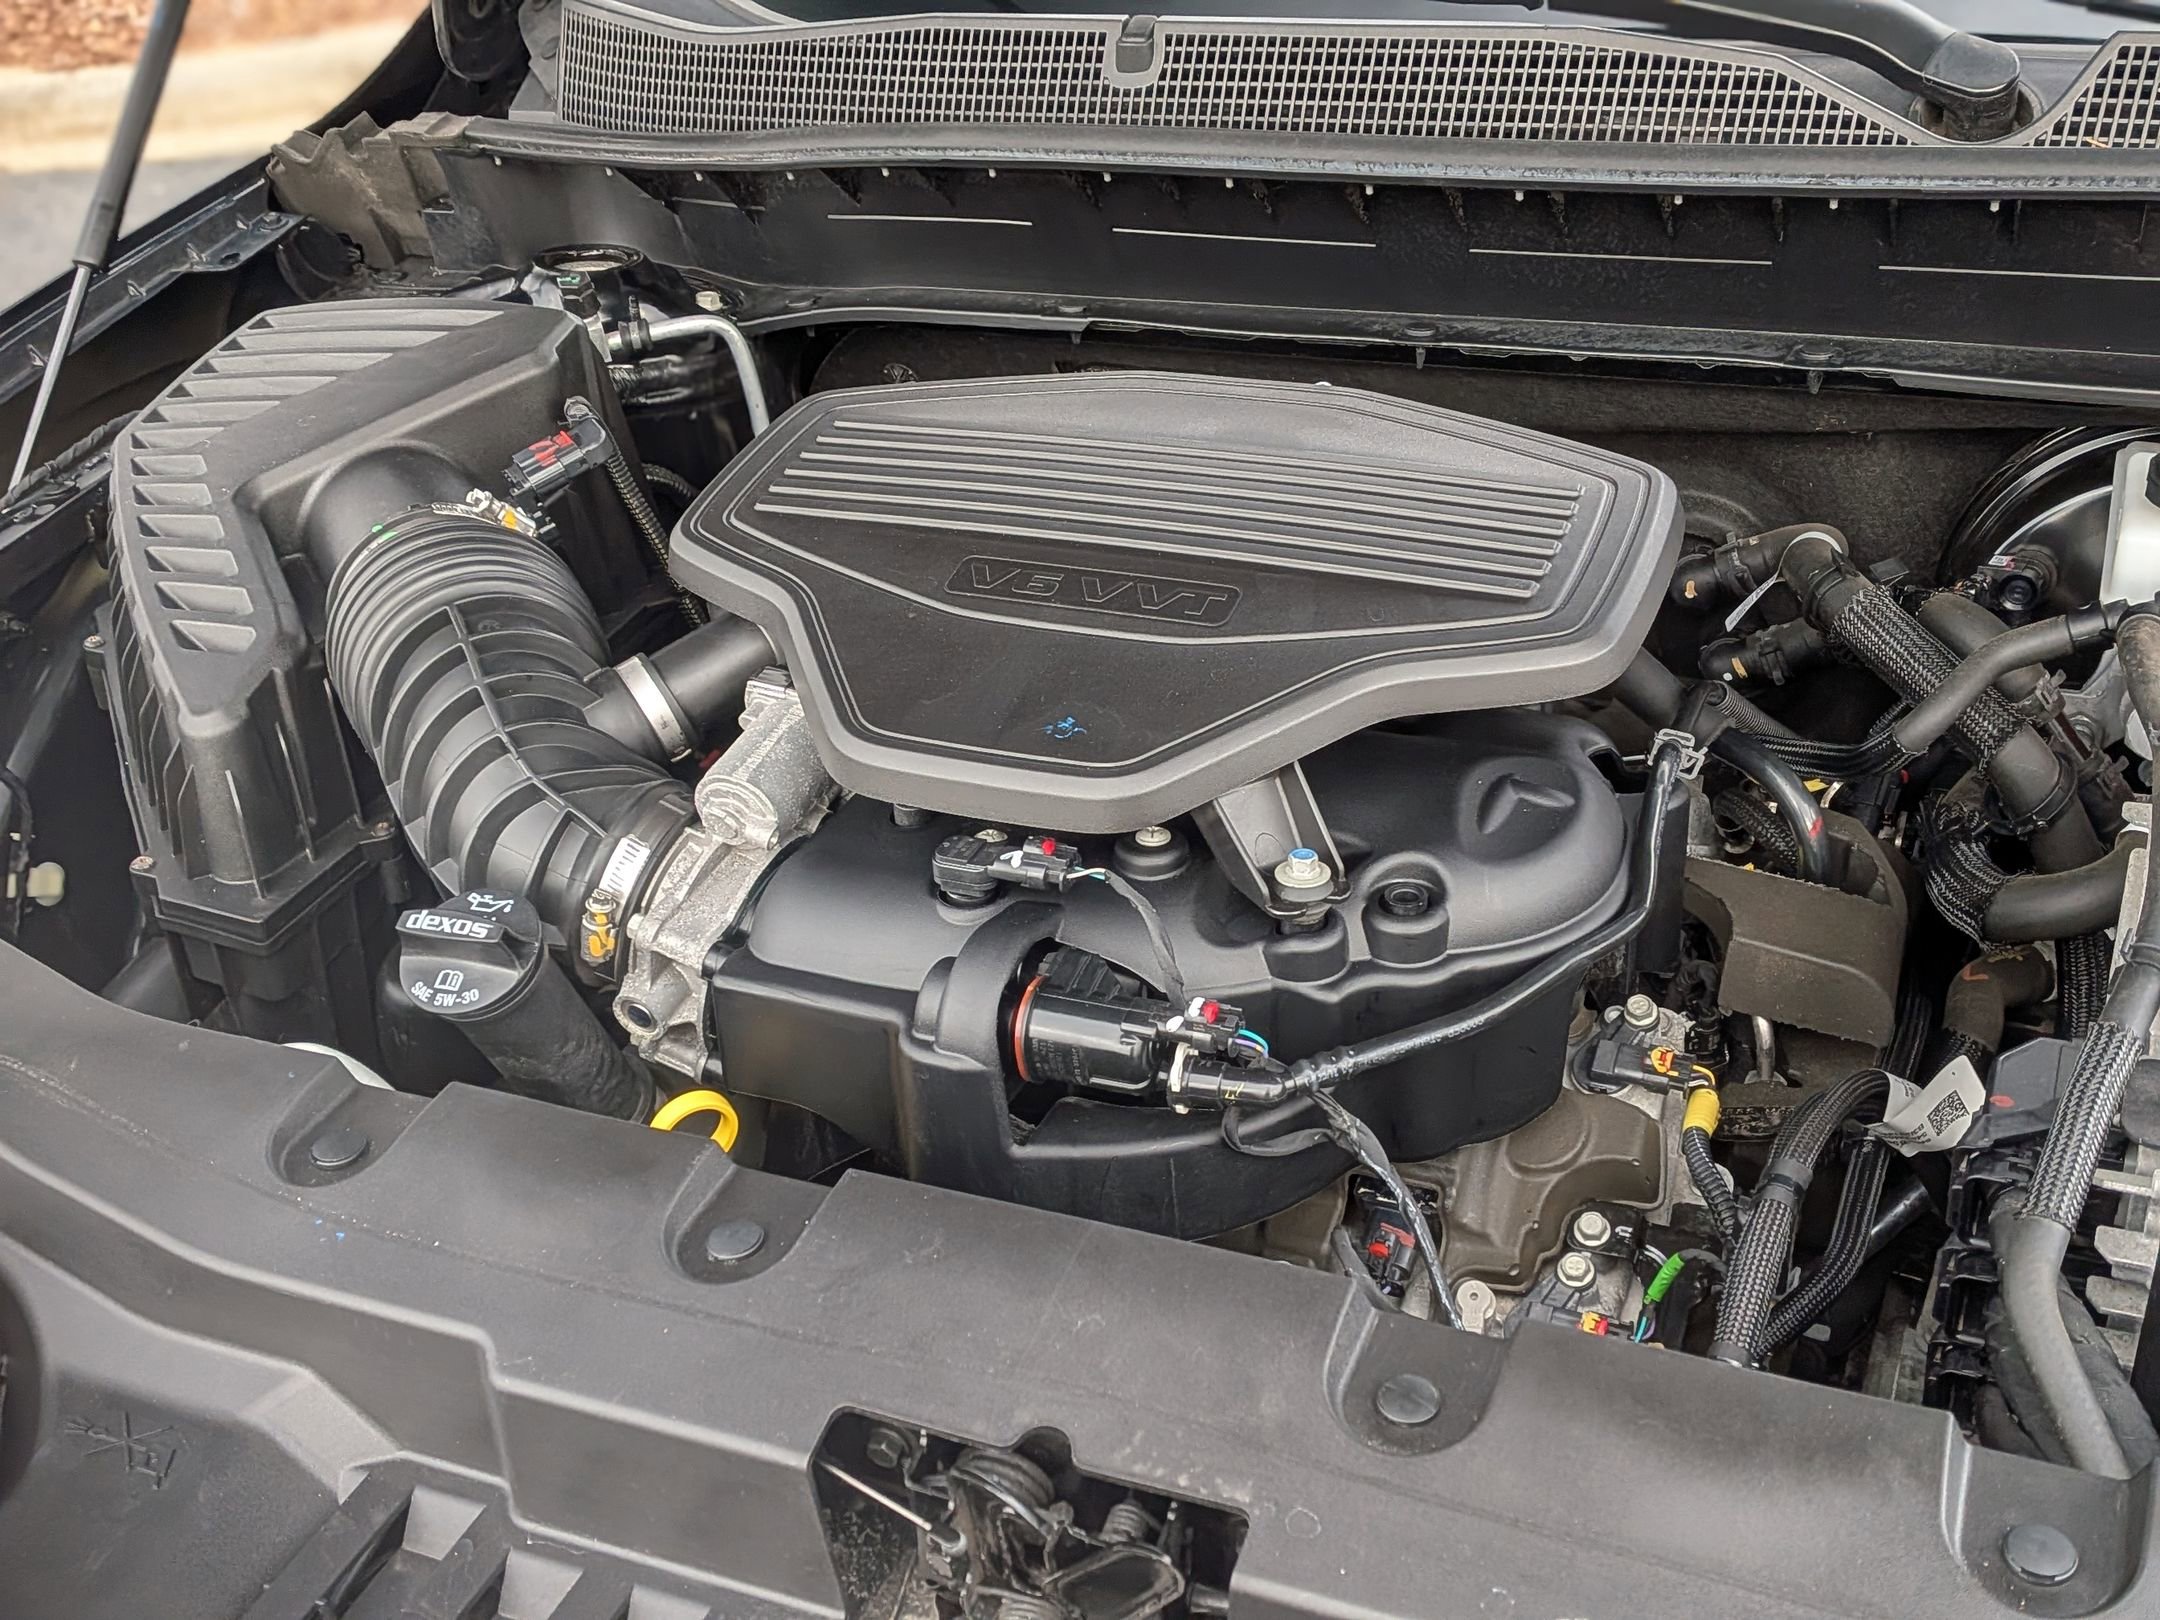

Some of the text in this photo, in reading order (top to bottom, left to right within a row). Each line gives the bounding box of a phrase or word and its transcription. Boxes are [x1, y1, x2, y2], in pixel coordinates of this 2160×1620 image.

[971, 563, 1229, 616] V6 VVT
[405, 909, 494, 939] dexos
[411, 981, 480, 1007] SAE 5W-30
